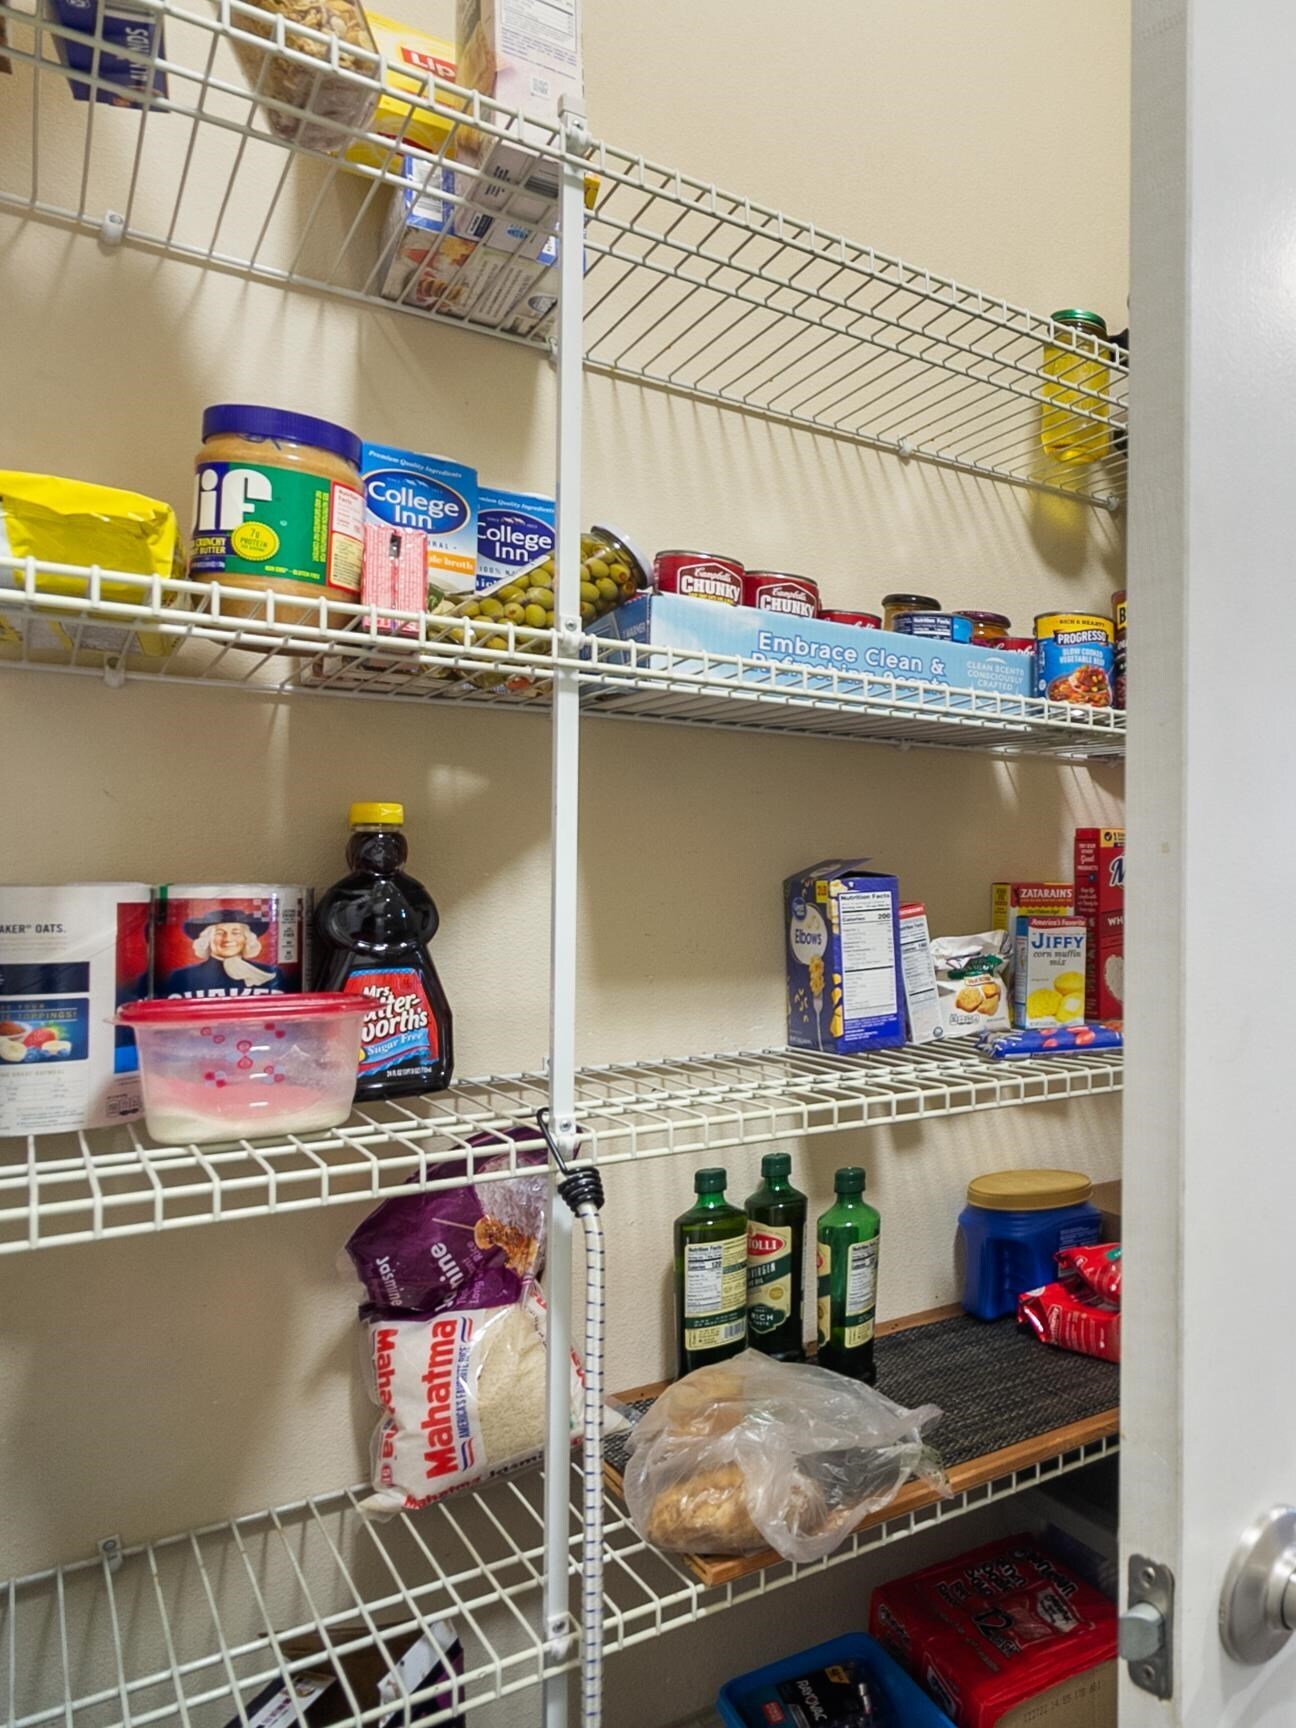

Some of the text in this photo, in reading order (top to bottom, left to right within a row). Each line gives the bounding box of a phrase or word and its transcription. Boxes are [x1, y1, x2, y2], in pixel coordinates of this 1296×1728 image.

[125, 26, 150, 82] ALNDS
[368, 450, 462, 479] Premium Quality Ingredients
[368, 481, 459, 519] College
[498, 499, 520, 509] Quality
[521, 503, 555, 514] Ingredients
[395, 505, 432, 530] Inn
[495, 542, 528, 562] Inn
[444, 557, 474, 571] broth
[681, 575, 741, 602] CHUNKY
[760, 594, 815, 618] CHUNKY
[1057, 630, 1108, 644] PROGRESSO
[758, 631, 947, 676] Embrace Clean &
[967, 661, 992, 673] CLEAN
[967, 670, 1024, 684] CONSCIOUSLY
[1031, 917, 1061, 926] America's
[795, 929, 822, 946] Elbows
[1031, 932, 1084, 949] JIFFY
[1049, 957, 1067, 966] mix
[1055, 949, 1082, 958] muffin
[363, 985, 393, 999] Mrs.
[367, 1032, 422, 1055] Sugar Free
[467, 1241, 484, 1262] Rice
[376, 1256, 403, 1307] Jasmine
[751, 1310, 774, 1321] RICH
[421, 1319, 459, 1480] Mahatma
[456, 1397, 470, 1439] AMERICA'S
[971, 1606, 1014, 1640] 12
[796, 1679, 828, 1721] RAYOVAC
